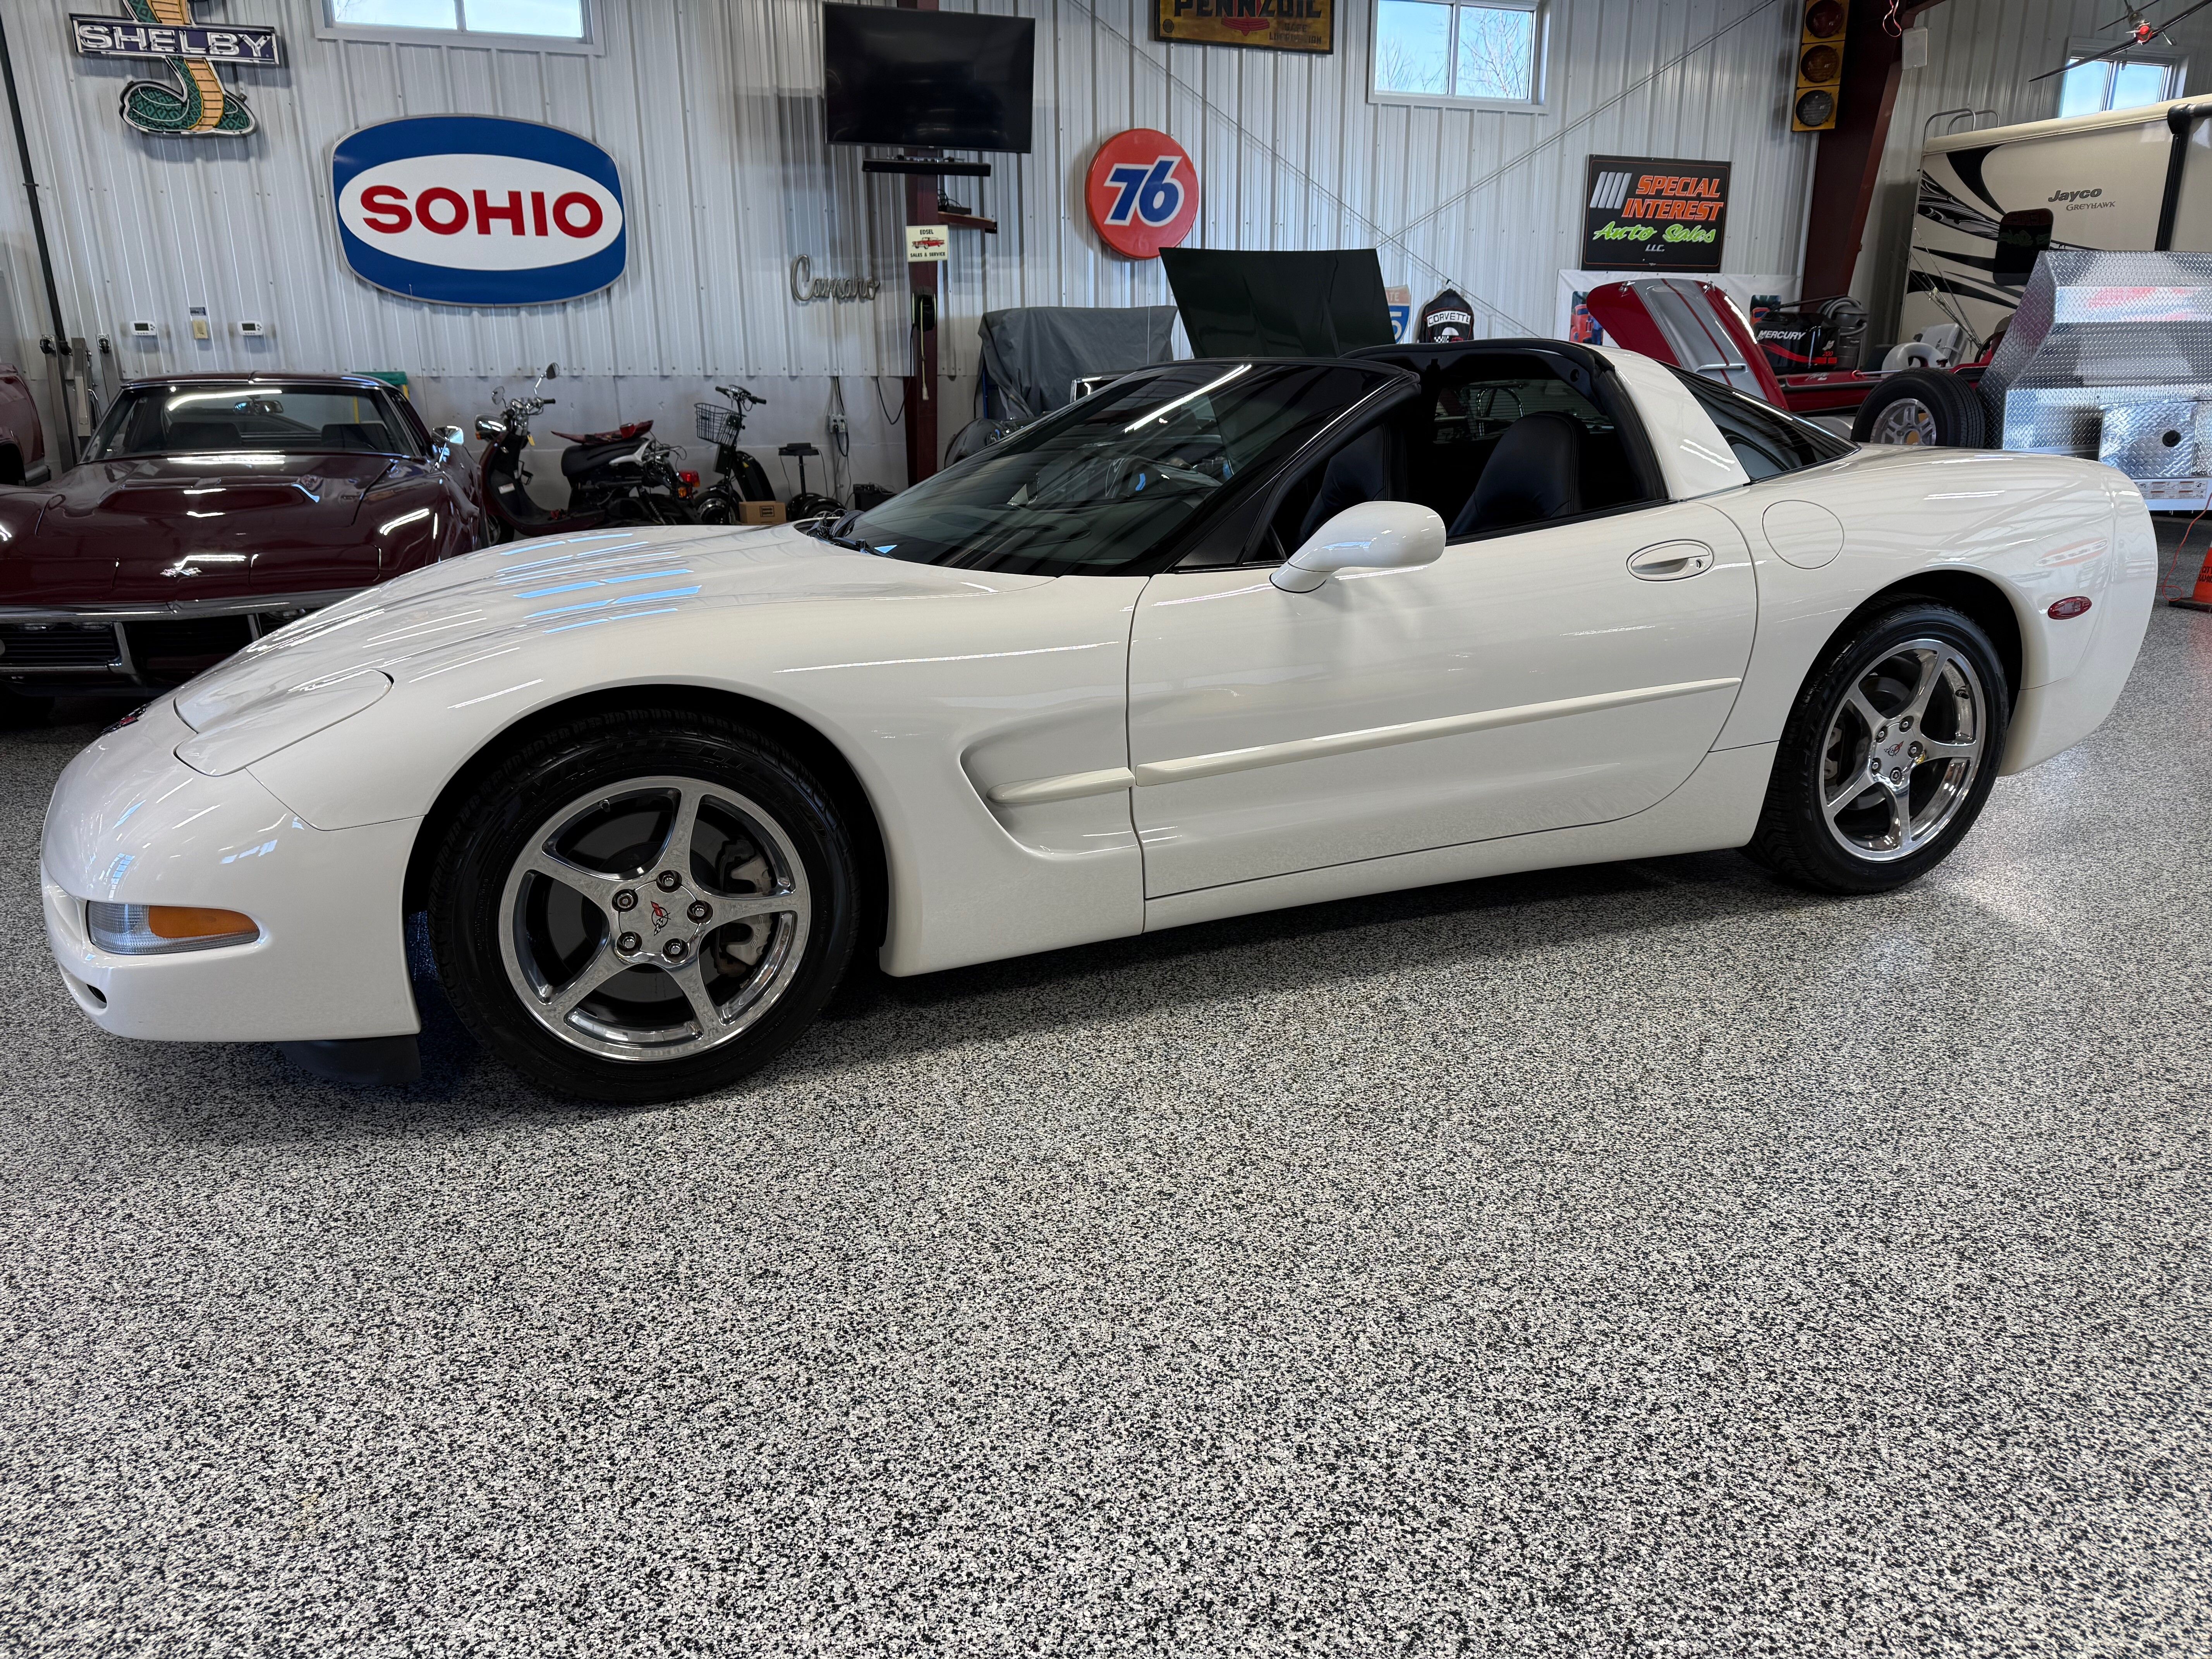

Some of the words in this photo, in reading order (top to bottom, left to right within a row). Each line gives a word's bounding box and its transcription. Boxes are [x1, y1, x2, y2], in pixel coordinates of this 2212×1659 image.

[78, 24, 271, 57] SHELBY
[1103, 155, 1185, 227] 76
[1635, 175, 1721, 198] SPECIAL
[2047, 188, 2102, 203] Jayco
[360, 185, 603, 239] SOHIO
[1621, 198, 1724, 221] INTEREST
[2066, 201, 2116, 211] GREYHAWK
[1592, 221, 1657, 241] Auto
[1662, 223, 1716, 243] Sales
[790, 254, 881, 301] Camaro
[1428, 312, 1469, 325] CORVETTE
[1757, 330, 1806, 340] MERCURY
